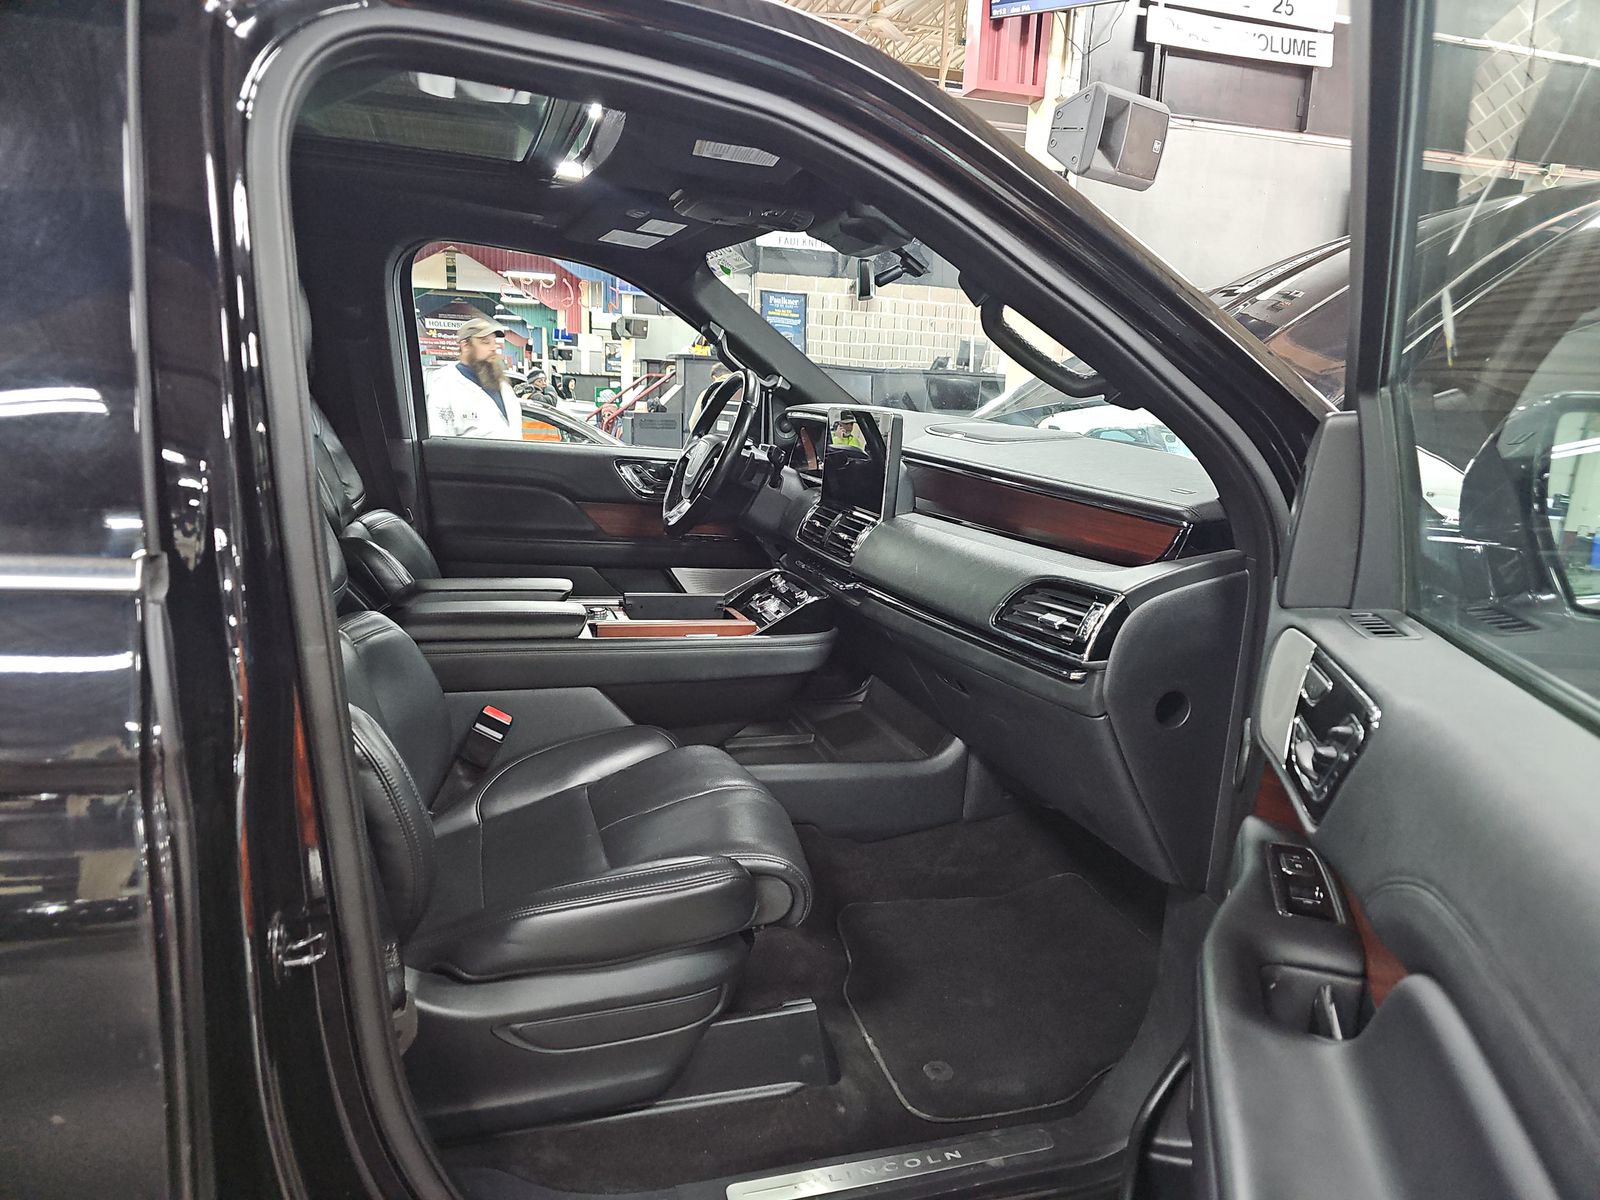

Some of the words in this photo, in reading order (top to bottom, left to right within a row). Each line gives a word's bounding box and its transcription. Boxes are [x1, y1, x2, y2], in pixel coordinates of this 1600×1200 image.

[1250, 32, 1317, 58] OLUME
[428, 320, 463, 328] HOLLENS
[828, 1150, 962, 1182] LINCOLN
